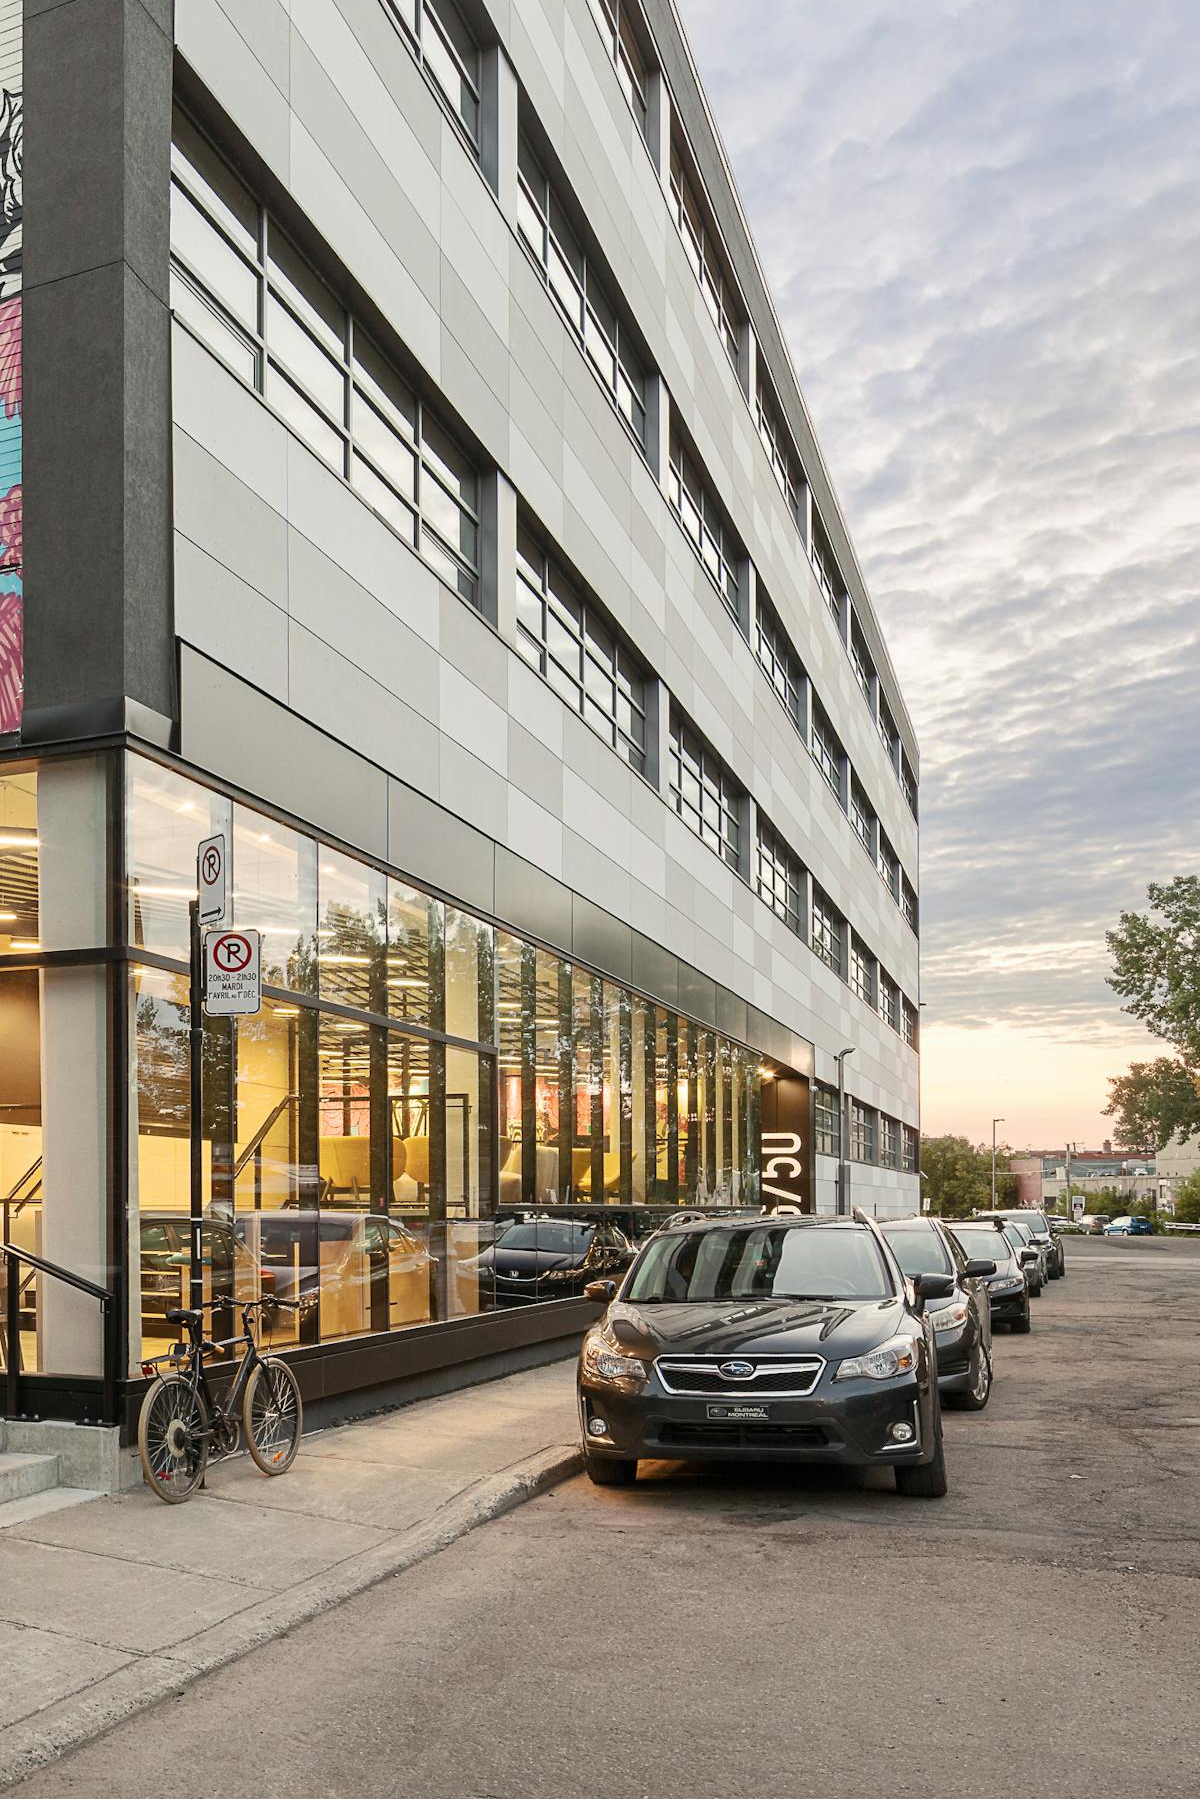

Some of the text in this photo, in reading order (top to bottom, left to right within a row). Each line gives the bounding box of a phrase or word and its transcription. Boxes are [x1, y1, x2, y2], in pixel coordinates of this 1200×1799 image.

[208, 973, 231, 982] 20h30
[236, 972, 257, 981] 21h30
[221, 982, 243, 991] MARDI
